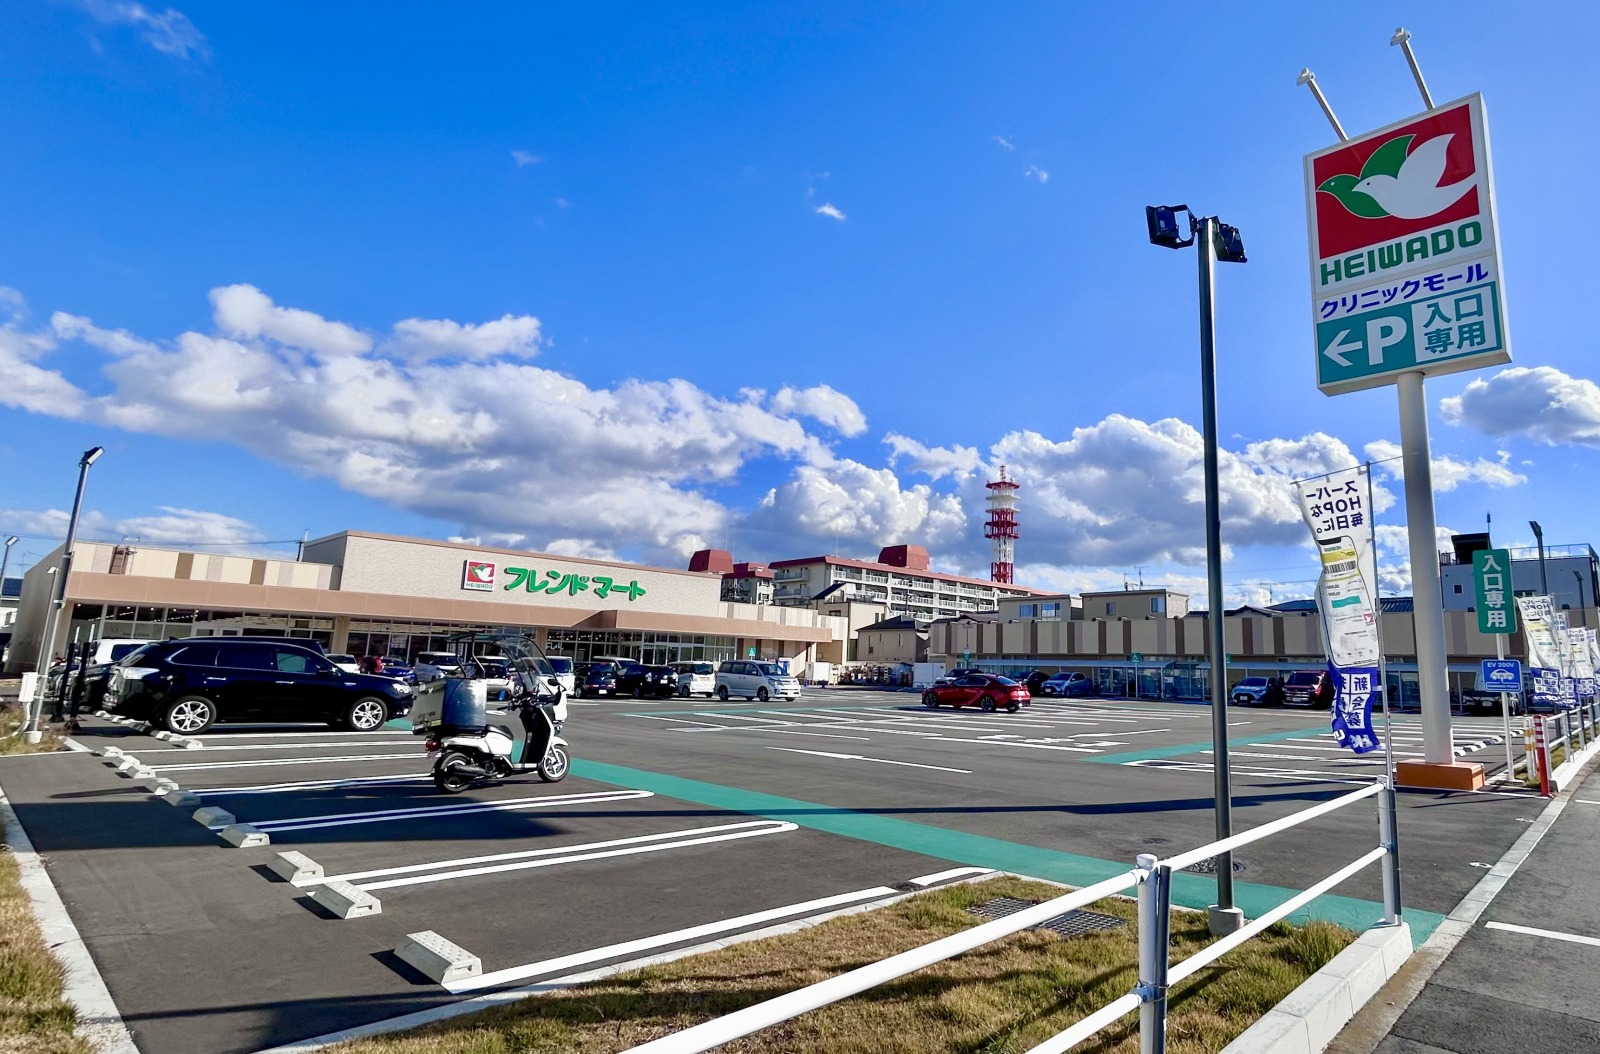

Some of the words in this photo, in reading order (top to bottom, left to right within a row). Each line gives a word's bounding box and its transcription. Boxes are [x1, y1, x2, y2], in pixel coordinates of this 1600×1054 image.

[1320, 220, 1482, 285] HEIWADO
[1320, 263, 1488, 318] クリニックモール
[1424, 292, 1482, 328] 入口
[1366, 315, 1407, 365] P
[1424, 320, 1486, 354] 専用
[504, 566, 646, 601] フレンドマート
[1481, 554, 1507, 628] 入口専用
